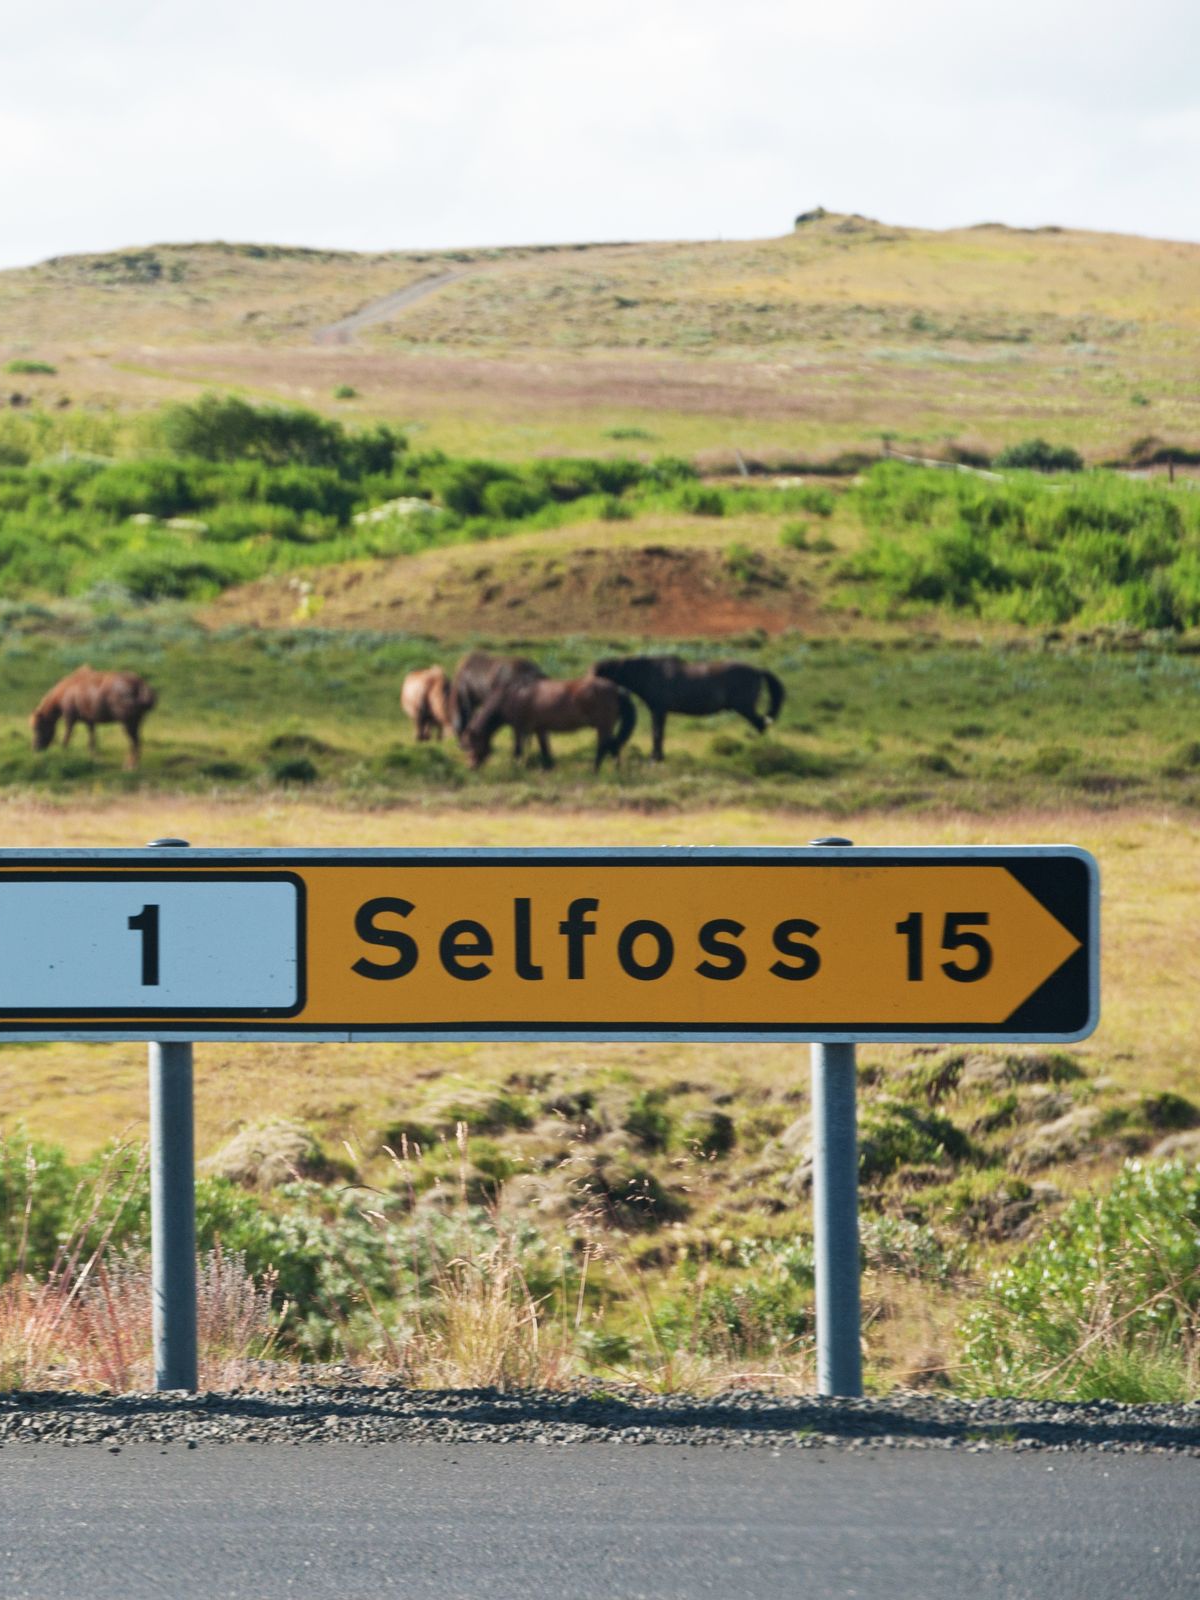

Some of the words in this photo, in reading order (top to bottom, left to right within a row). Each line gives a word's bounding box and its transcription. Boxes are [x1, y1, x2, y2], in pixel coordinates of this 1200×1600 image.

[127, 904, 161, 986] 1
[350, 896, 823, 982] Selfoss
[895, 911, 995, 984] 15
